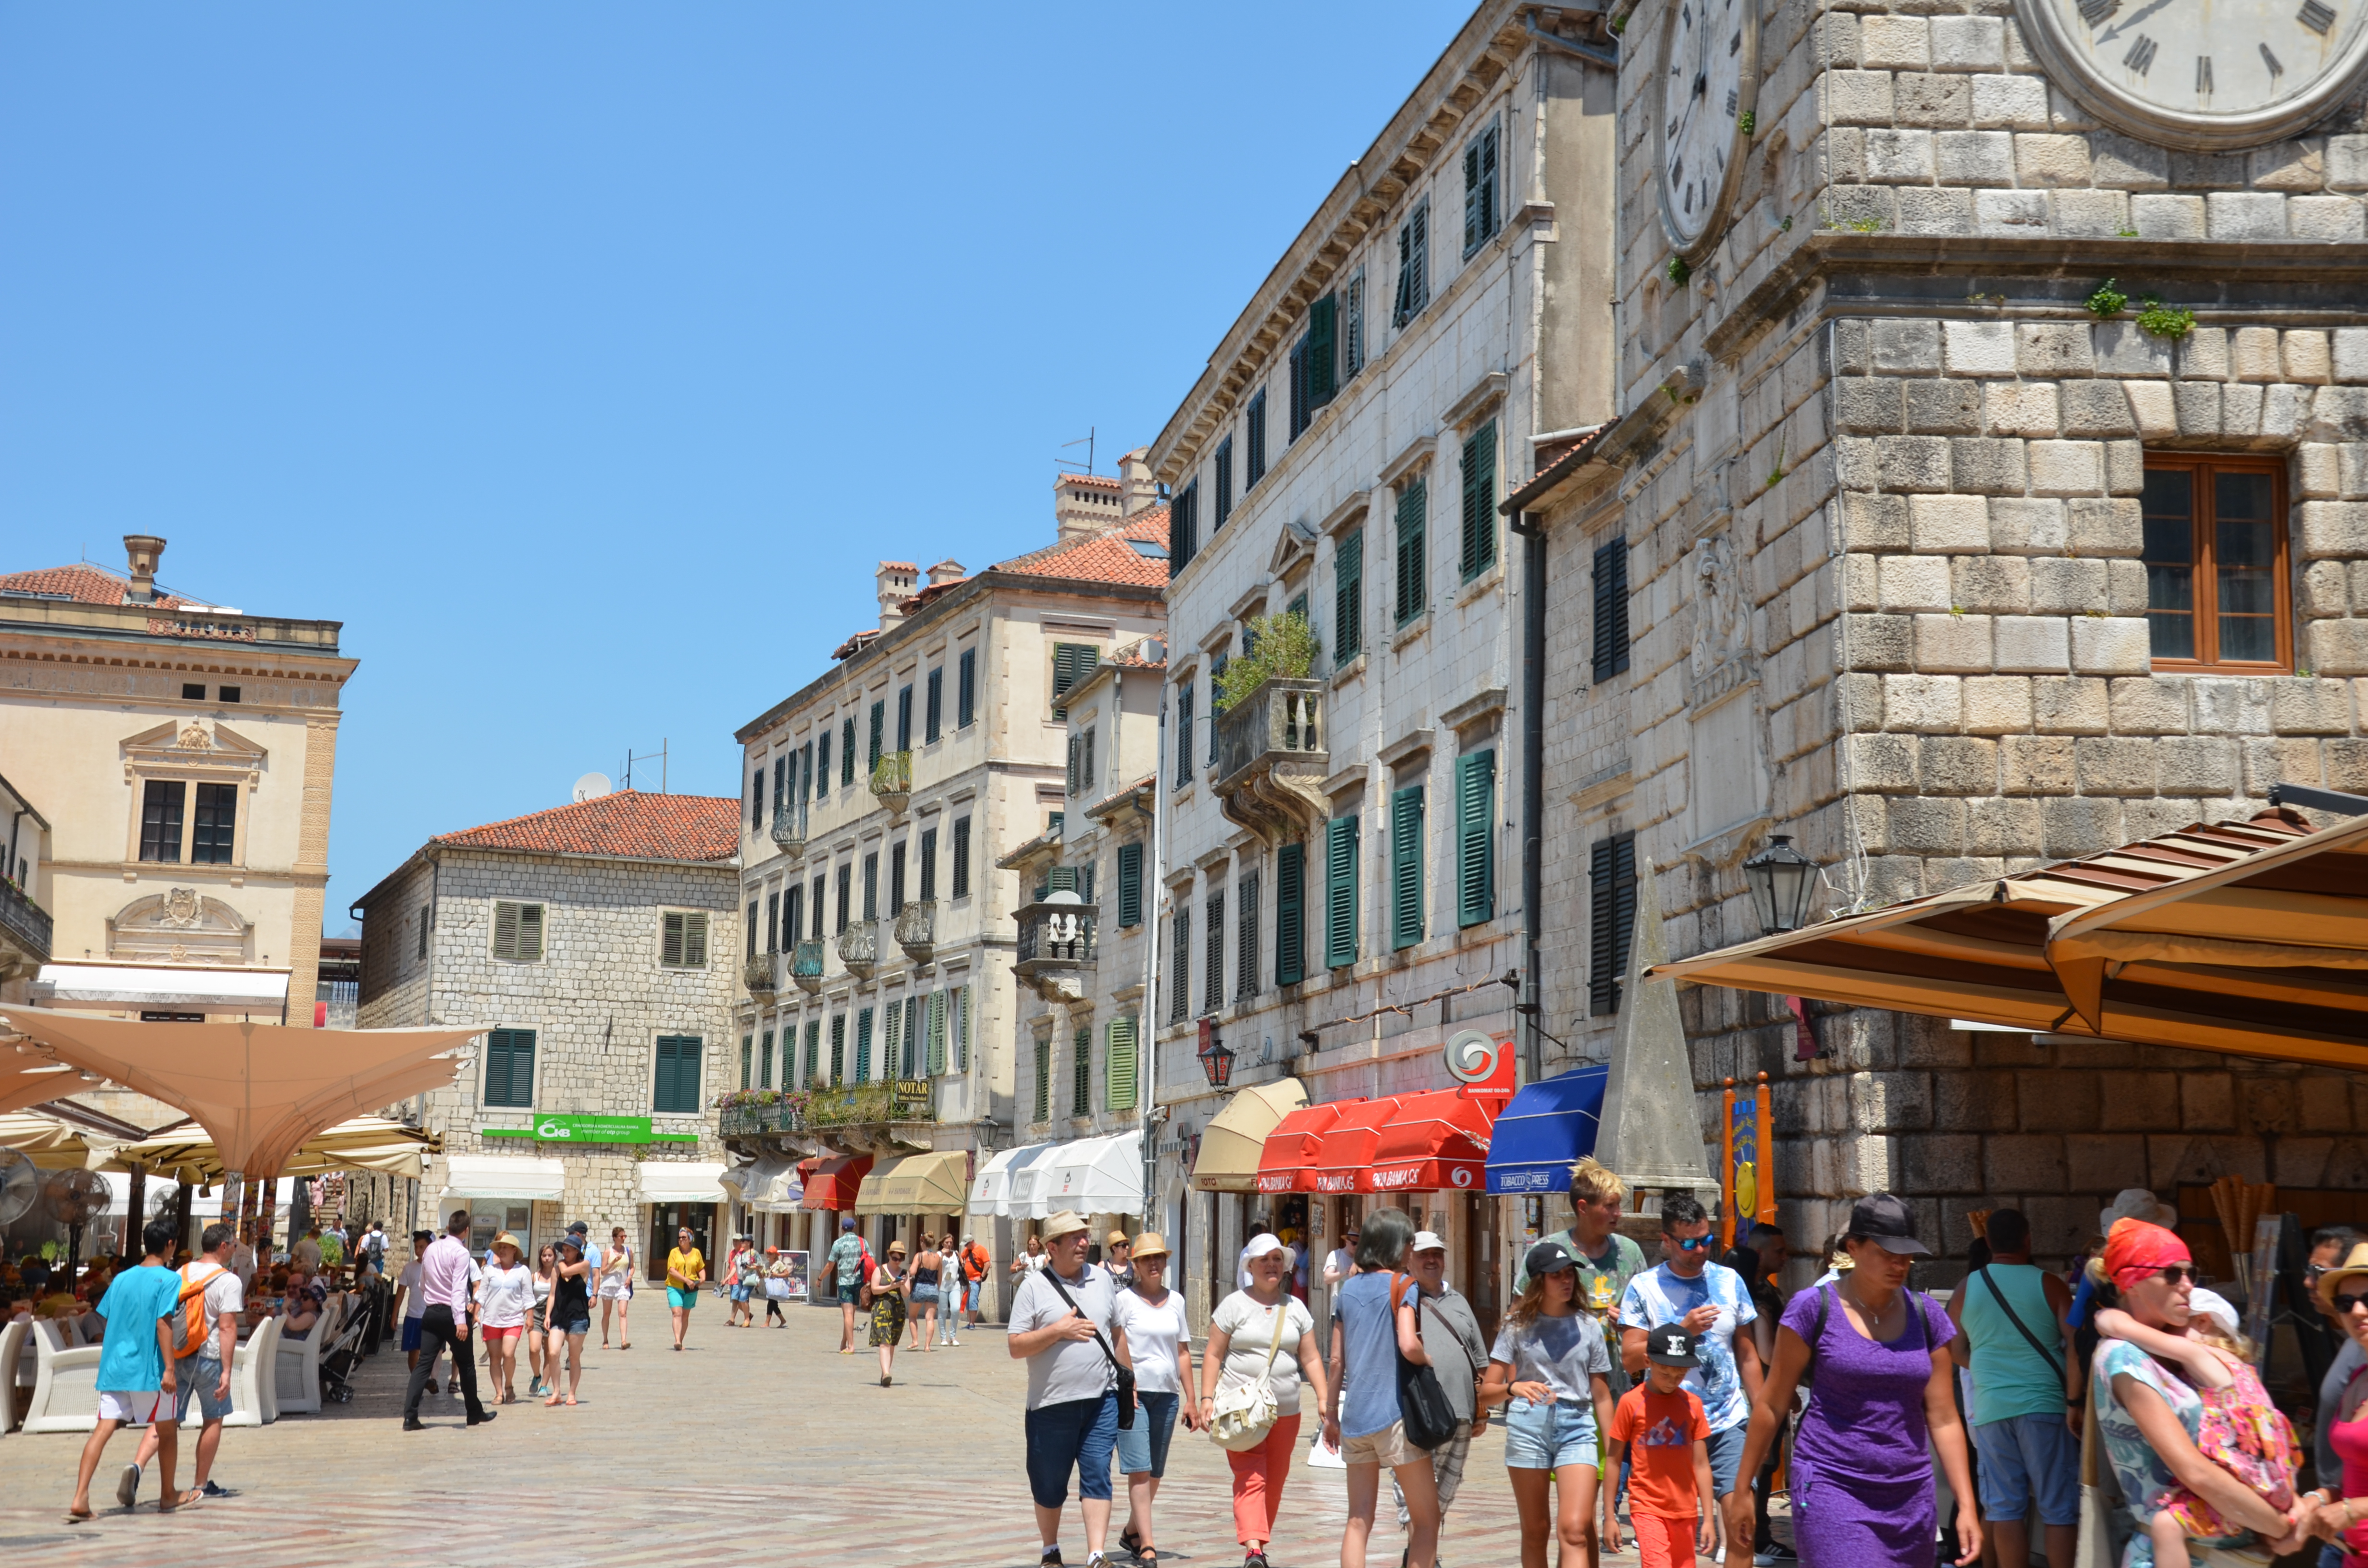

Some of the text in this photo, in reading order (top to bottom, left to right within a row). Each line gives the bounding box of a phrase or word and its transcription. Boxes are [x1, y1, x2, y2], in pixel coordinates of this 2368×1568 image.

[1205, 1058, 1216, 1080] FOTO
[1219, 1057, 1228, 1080] FOTO
[898, 1082, 927, 1094] NOTAR
[1201, 1178, 1216, 1186] FOTO
[1501, 1176, 1525, 1187] TOBACCO
[1531, 1174, 1550, 1185] PRESS
